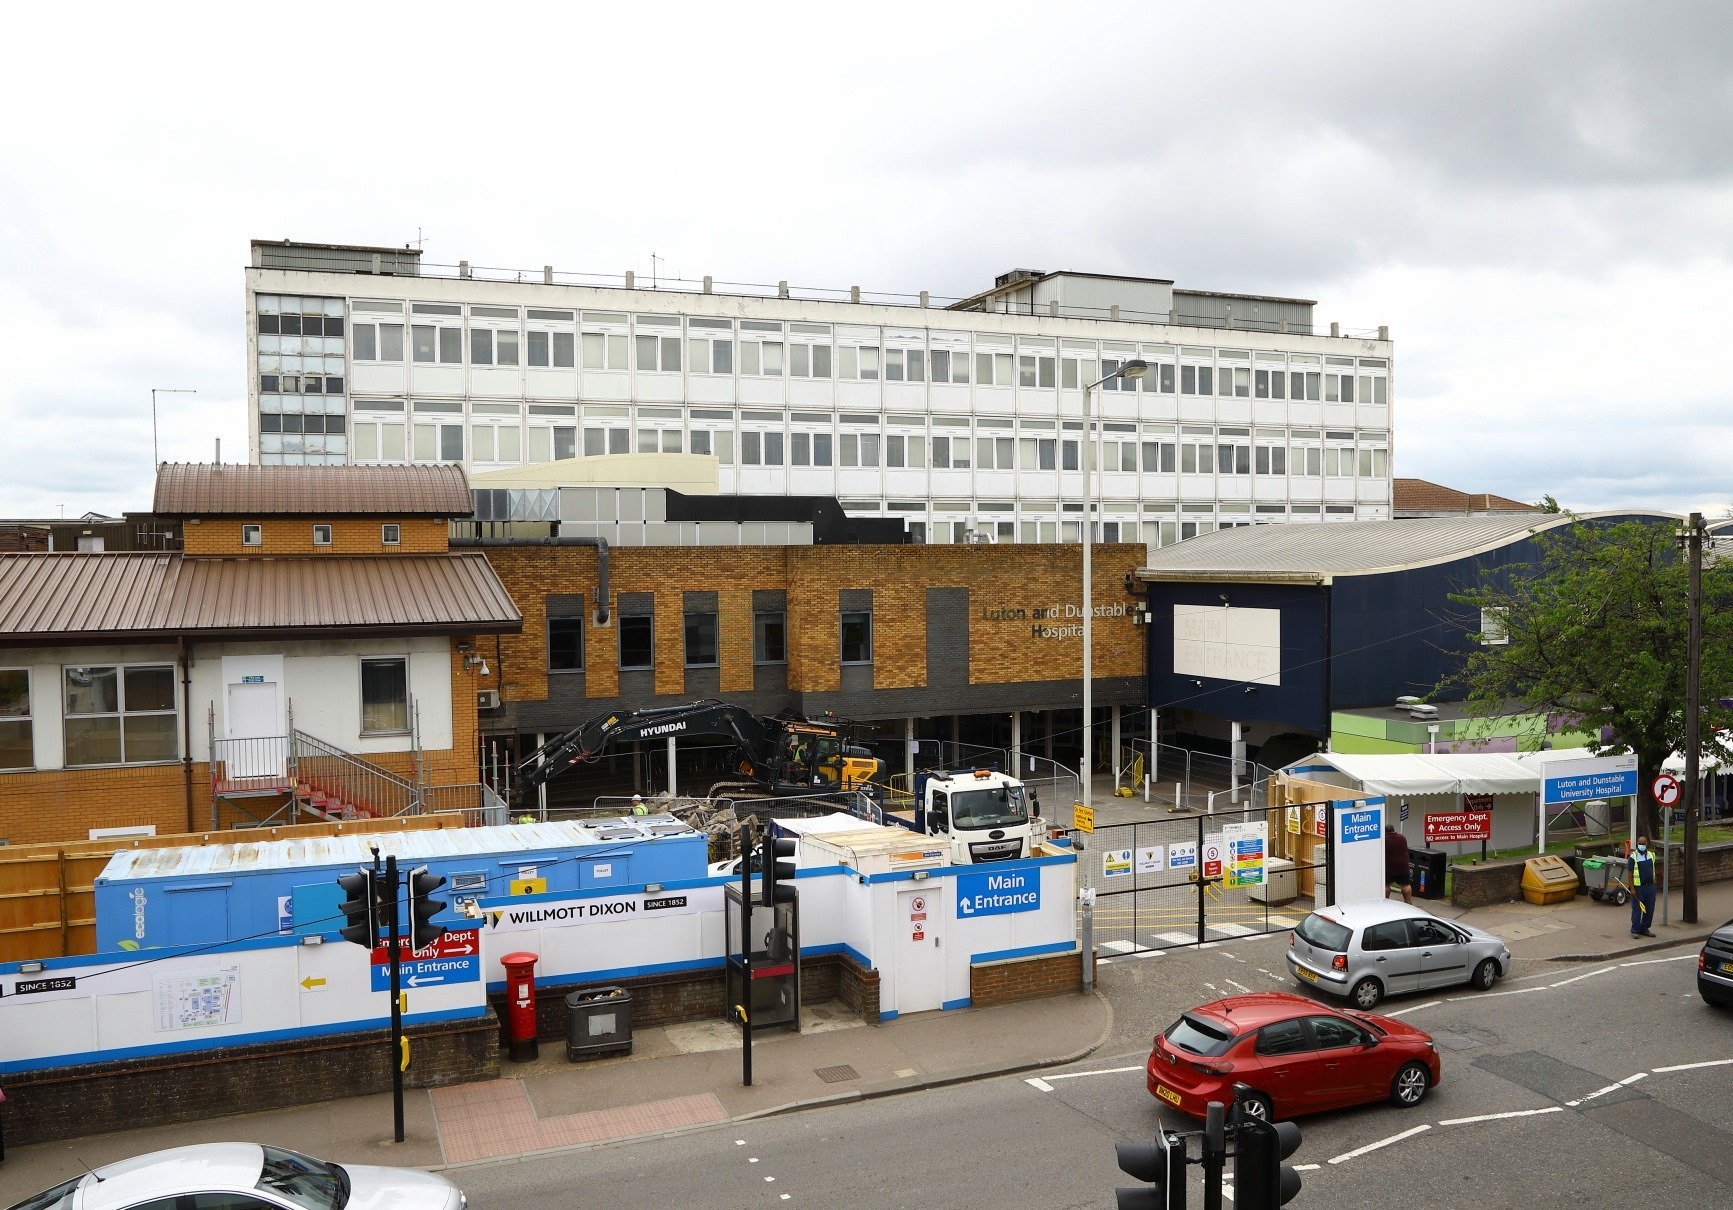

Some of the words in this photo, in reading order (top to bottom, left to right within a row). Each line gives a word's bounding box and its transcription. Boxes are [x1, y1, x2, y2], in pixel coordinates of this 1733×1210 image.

[982, 605, 1026, 621] Luton
[1032, 604, 1060, 620] and
[1031, 624, 1085, 641] Hospita
[640, 721, 687, 737] HYUNDAI
[1557, 779, 1577, 789] Luton
[1578, 778, 1591, 787] and
[1592, 775, 1625, 785] Dunstable
[1560, 787, 1594, 798] University
[1595, 785, 1622, 795] Hospital
[1351, 813, 1372, 824] Main
[1427, 815, 1467, 824] Emergency
[1469, 813, 1488, 822] Dept.
[1344, 823, 1379, 835] Entrance
[1438, 824, 1462, 832] Access
[1464, 823, 1481, 832] Only
[1469, 832, 1488, 840] Hospital
[988, 875, 1025, 891] Main
[647, 900, 666, 909] SINCE
[668, 898, 684, 906] 1852
[975, 891, 1037, 909] Entrance
[509, 905, 586, 924] WILLMOTT
[589, 901, 636, 917] DIXON
[444, 931, 475, 944] Dept.
[381, 964, 413, 977] Min
[417, 960, 470, 973] Entrance
[20, 982, 48, 992] SINCE
